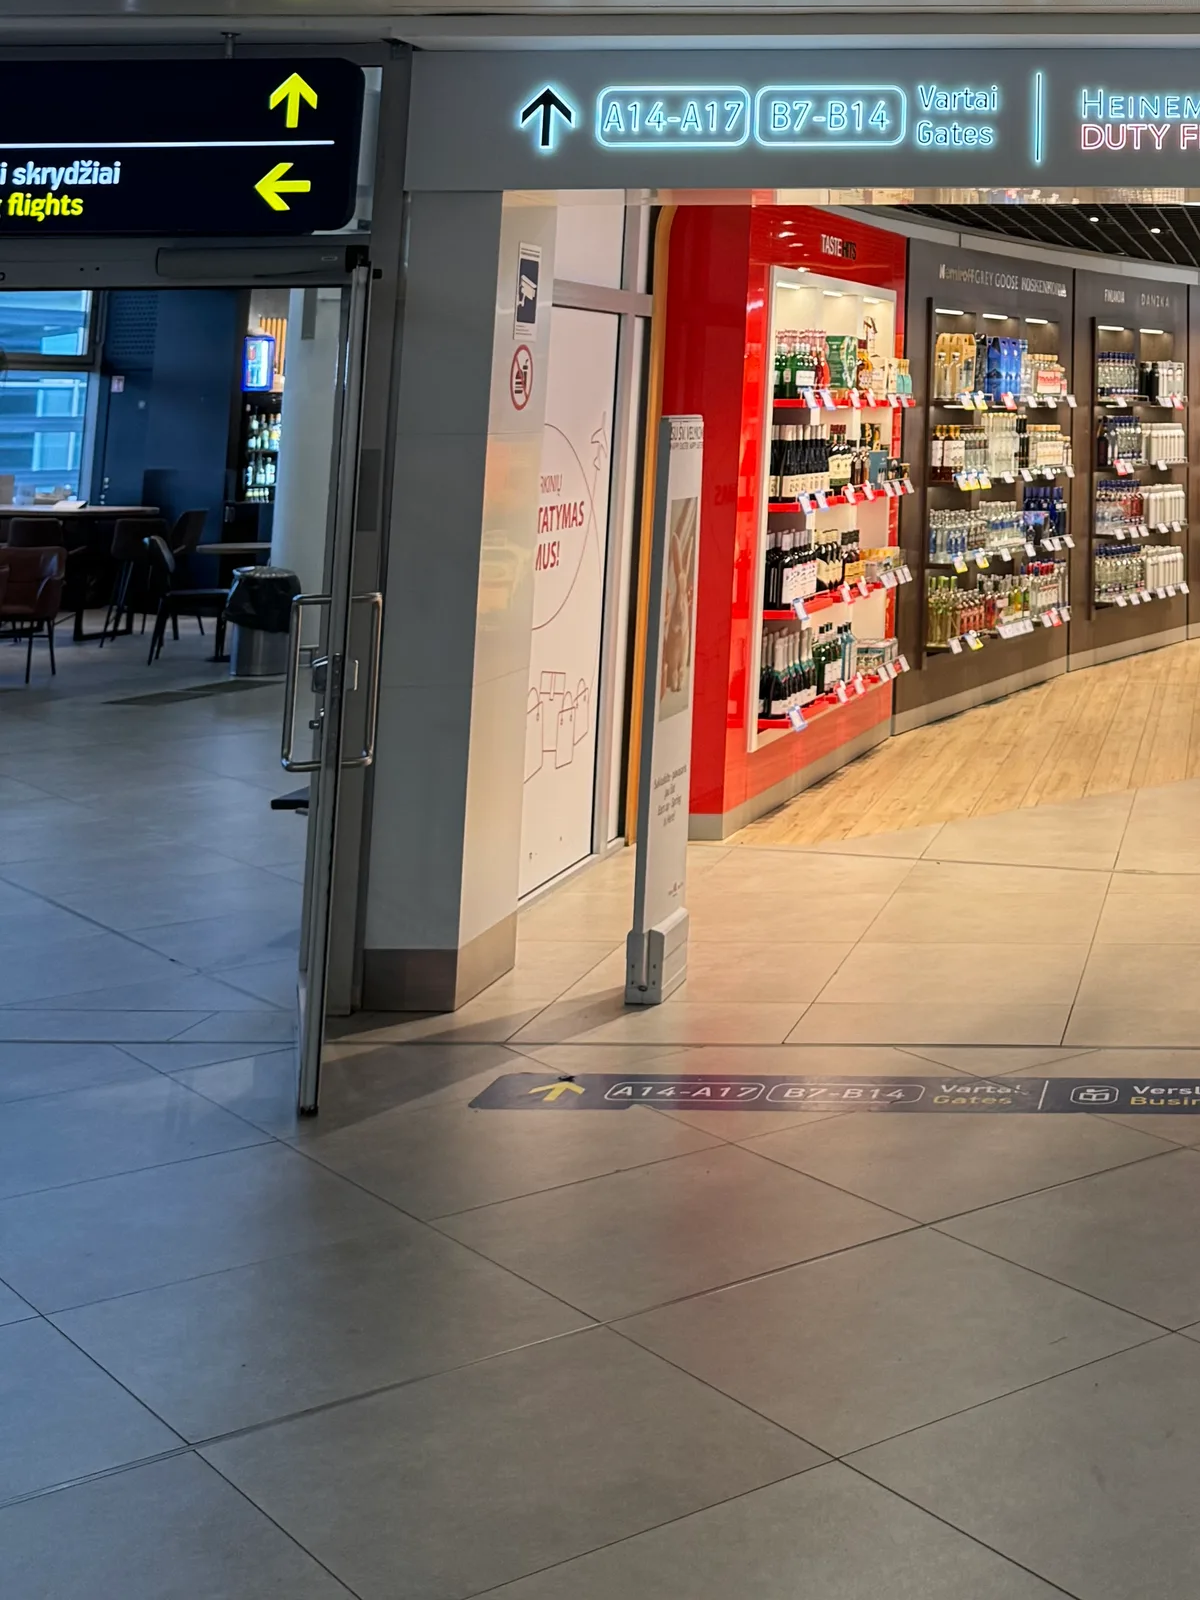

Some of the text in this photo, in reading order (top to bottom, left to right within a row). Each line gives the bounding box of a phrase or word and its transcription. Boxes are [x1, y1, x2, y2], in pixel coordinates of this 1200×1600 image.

[917, 84, 999, 111] Vartai
[602, 101, 743, 133] A14-A17
[771, 101, 891, 133] B7-B14
[916, 120, 993, 146] Gates
[1080, 123, 1171, 151] DUTY
[12, 160, 121, 191] skrydžiai
[8, 192, 84, 222] flights
[975, 269, 1019, 290] GREY GOOSE
[1141, 293, 1170, 309] DANZKA
[612, 1086, 758, 1098] A14-A17
[783, 1087, 906, 1099] B7-B14
[932, 1095, 1013, 1105] Gates
